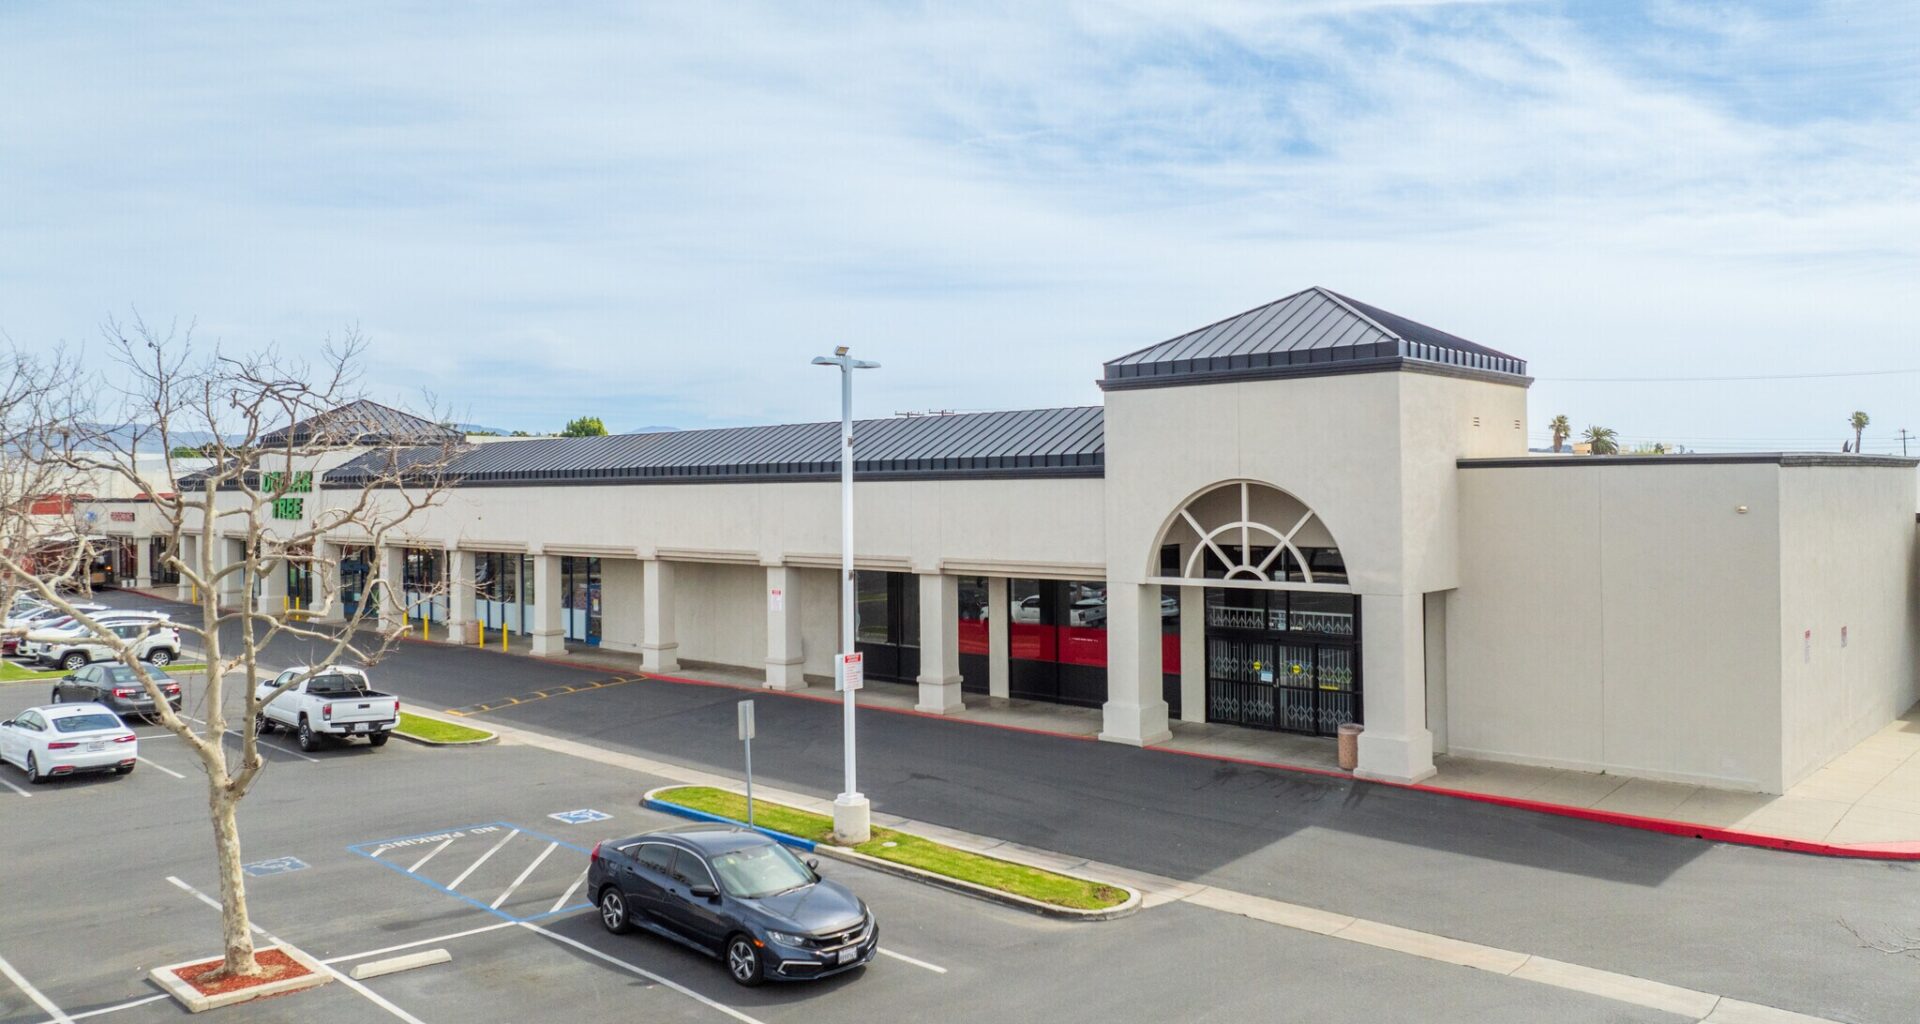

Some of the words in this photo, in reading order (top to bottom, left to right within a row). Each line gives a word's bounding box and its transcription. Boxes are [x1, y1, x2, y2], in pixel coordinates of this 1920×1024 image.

[271, 497, 303, 519] TREE
[470, 826, 499, 834] NO
[379, 832, 465, 848] PARKING
